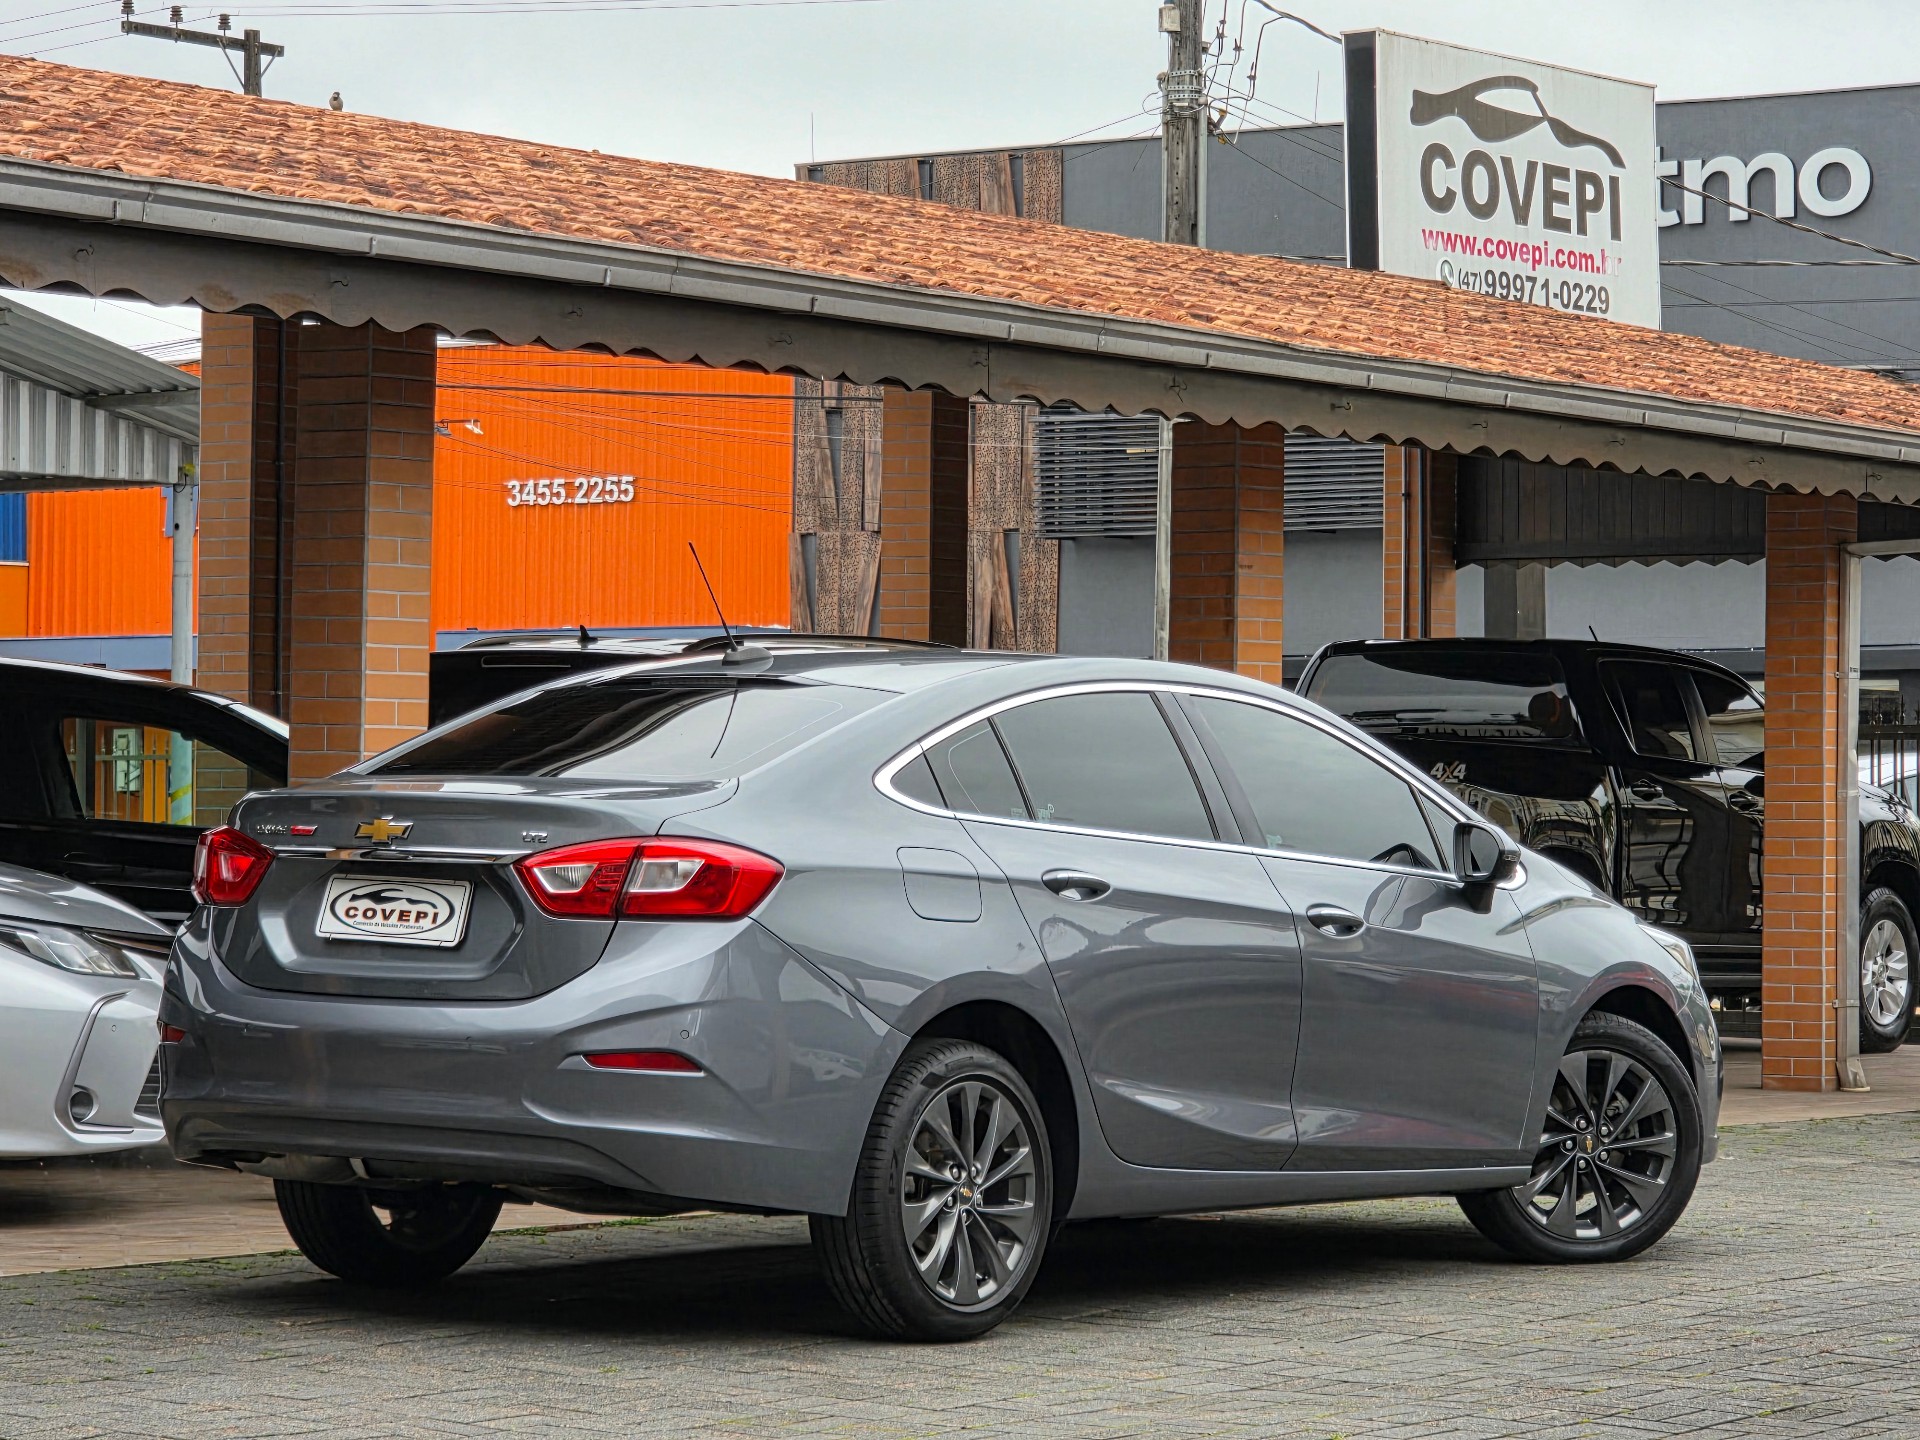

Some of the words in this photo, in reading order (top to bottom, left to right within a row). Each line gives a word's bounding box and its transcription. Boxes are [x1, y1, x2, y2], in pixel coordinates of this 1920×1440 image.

[1420, 142, 1622, 241] COVEPI
[1421, 228, 1622, 277] www.covepi.com.br
[507, 475, 635, 507] 3455.2255
[344, 905, 440, 926] COVEPI
